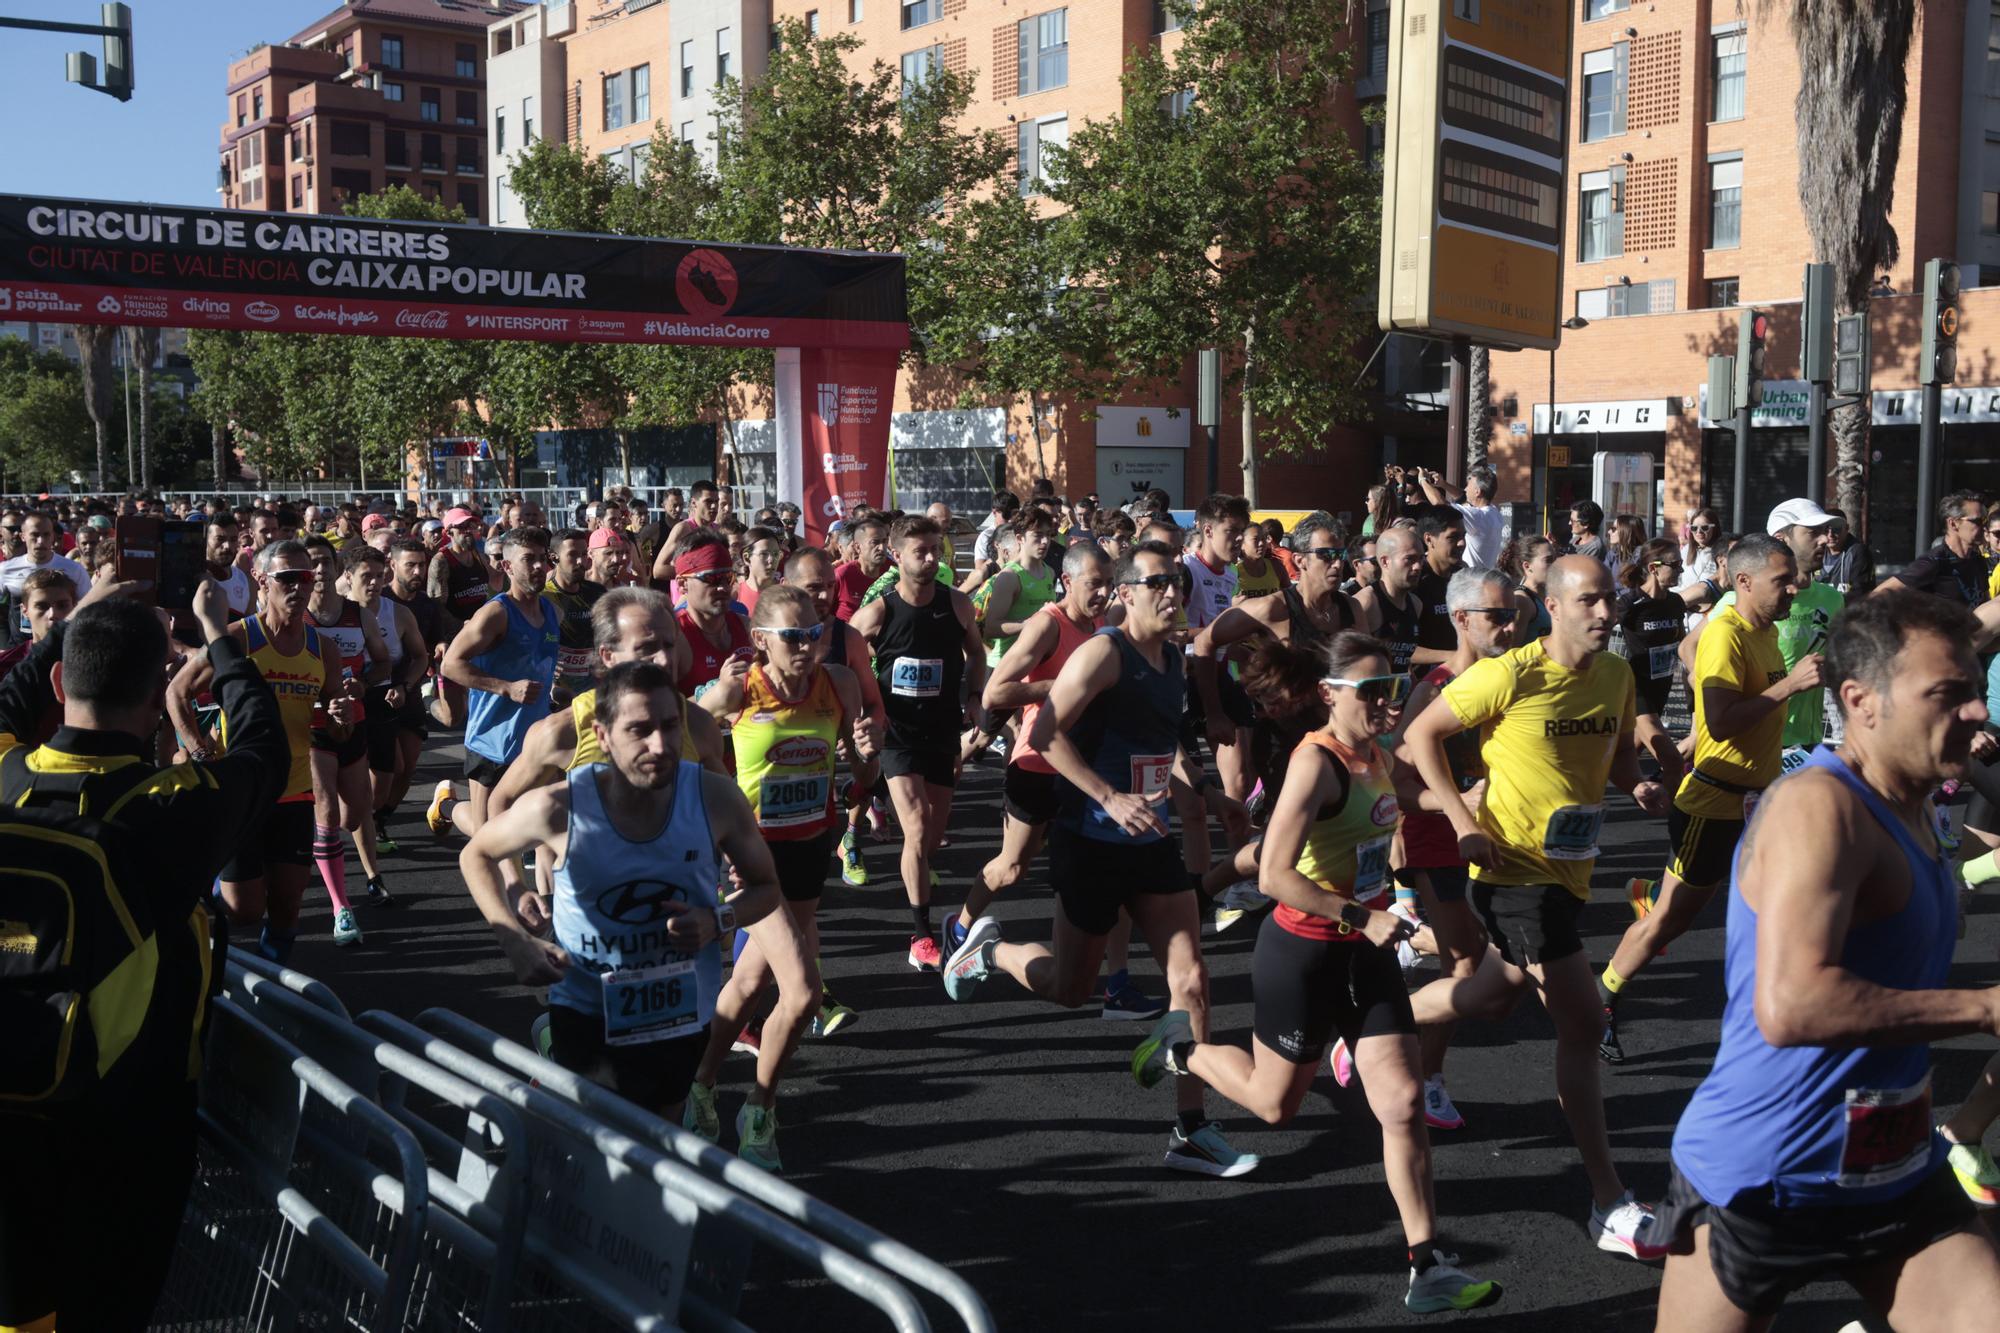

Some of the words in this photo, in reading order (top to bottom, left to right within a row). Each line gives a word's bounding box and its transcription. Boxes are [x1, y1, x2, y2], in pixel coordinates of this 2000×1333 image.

[27, 206, 185, 244] CIRCUIT
[196, 218, 247, 248] DE
[254, 222, 450, 262] CARRERES
[28, 246, 124, 273] CIUTAT
[130, 252, 166, 276] DE
[172, 251, 301, 282] VALÈNCIA
[306, 257, 425, 292] CAIXA
[428, 265, 587, 300] POPULAR
[16, 289, 59, 301] caixa
[16, 299, 83, 313] popular
[124, 301, 169, 310] TRINIDAD
[183, 298, 231, 313] divina
[124, 310, 169, 319] ALFONSO
[480, 315, 569, 332] INTERSPORT
[588, 320, 626, 330] aspaym
[643, 320, 771, 339] #ValènciaCorre
[840, 385, 877, 395] Fundació
[1763, 390, 1809, 404] Urban
[839, 396, 878, 406] Esportiva
[839, 405, 878, 415] Municipal
[1544, 717, 1618, 737] REDOLAT
[775, 745, 828, 762] Serrano
[769, 780, 819, 806] 2060
[619, 978, 683, 1018] 2166
[597, 1222, 674, 1299] RUNNING
